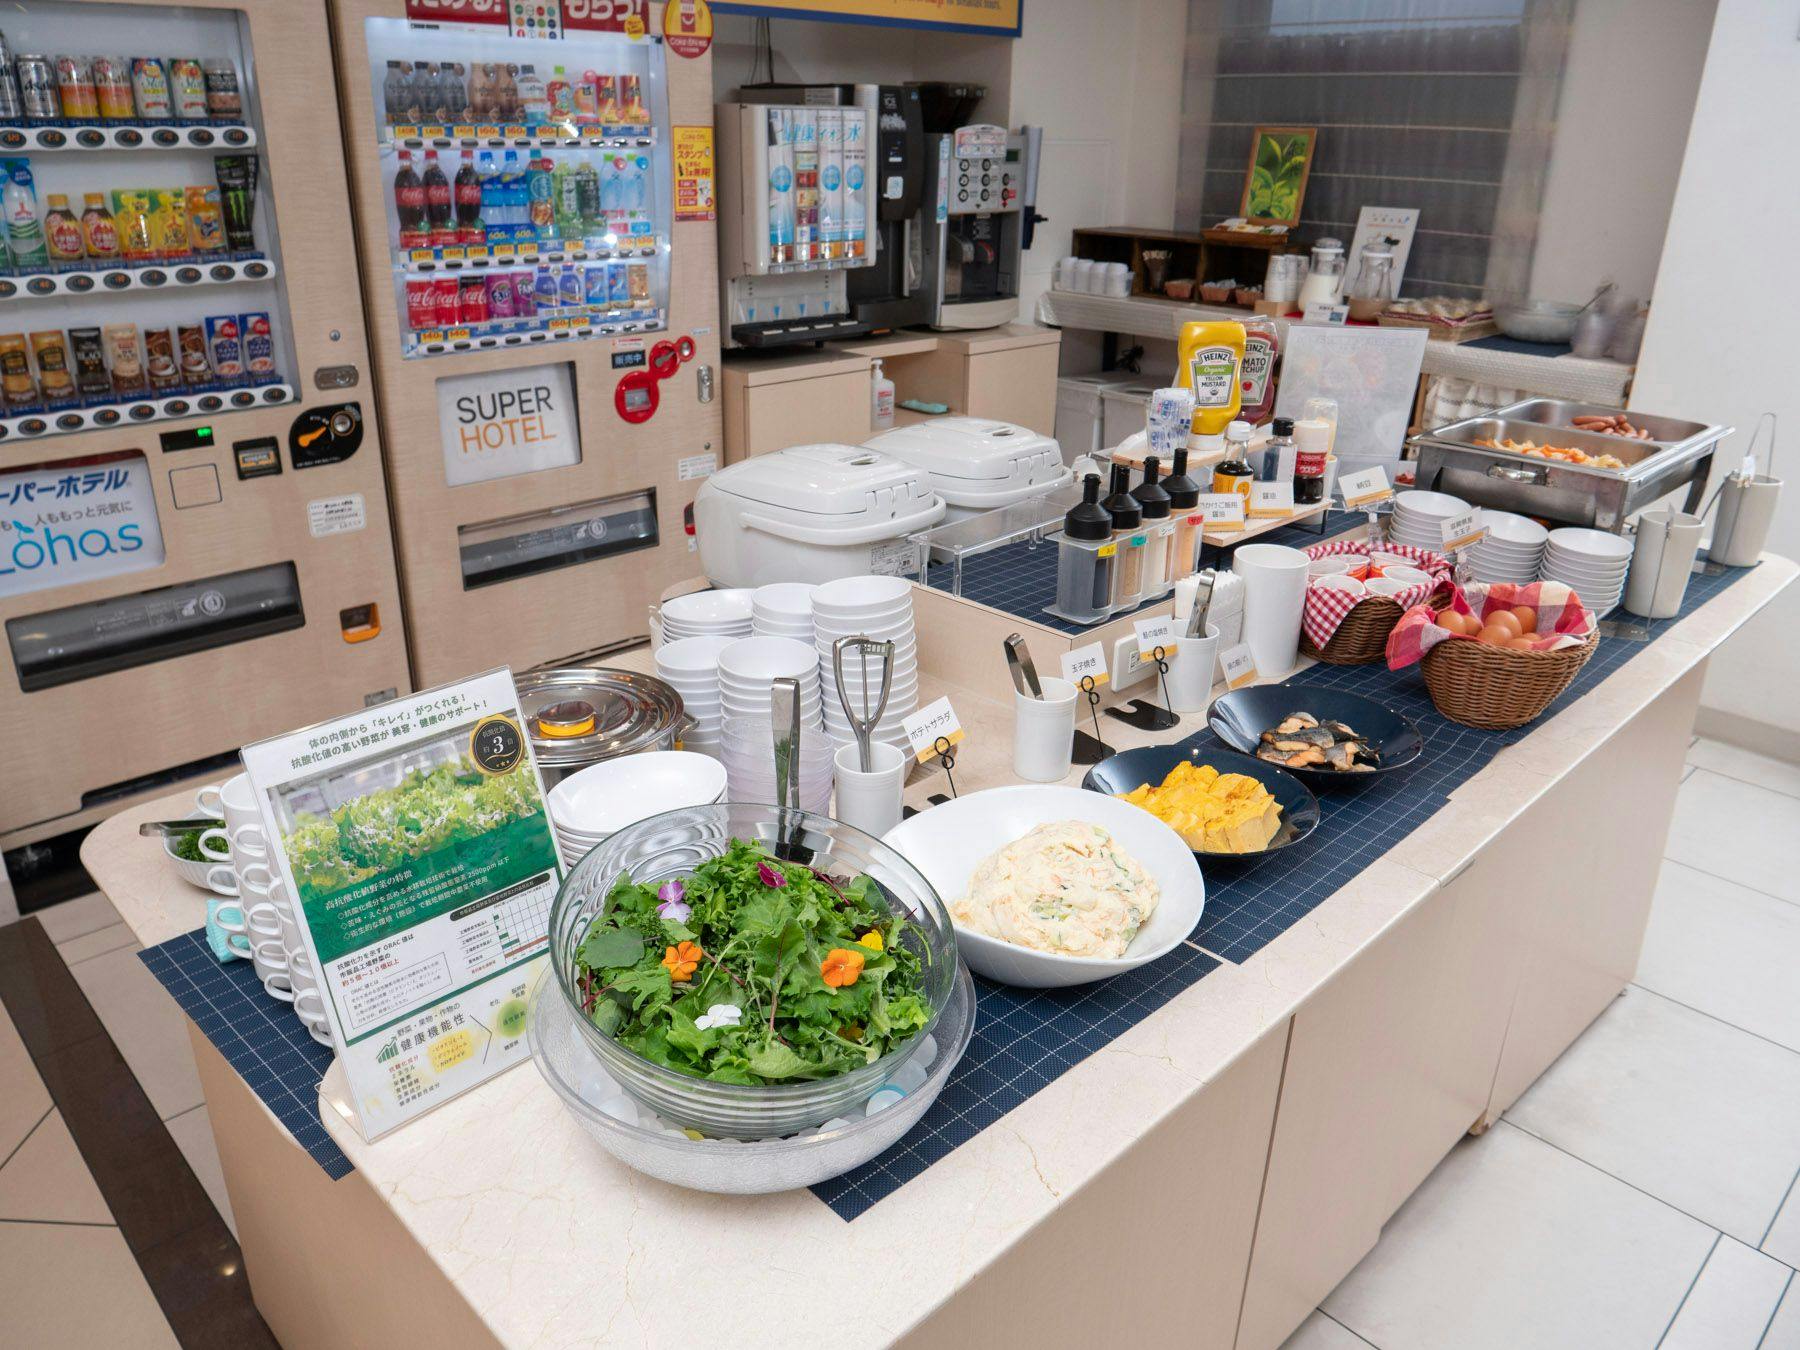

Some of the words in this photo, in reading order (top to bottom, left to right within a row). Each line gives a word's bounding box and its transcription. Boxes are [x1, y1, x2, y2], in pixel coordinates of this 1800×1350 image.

[1203, 351, 1229, 362] HEINZ
[1245, 342, 1263, 354] EINZ
[457, 386, 553, 423] SUPER
[460, 417, 557, 453] HOTEL
[1072, 657, 1097, 674] 玉子焼き
[910, 710, 951, 740] ポテトサラダ
[491, 734, 505, 755] 3
[383, 940, 401, 951] ORAC
[400, 1013, 466, 1053] 健康機能性
